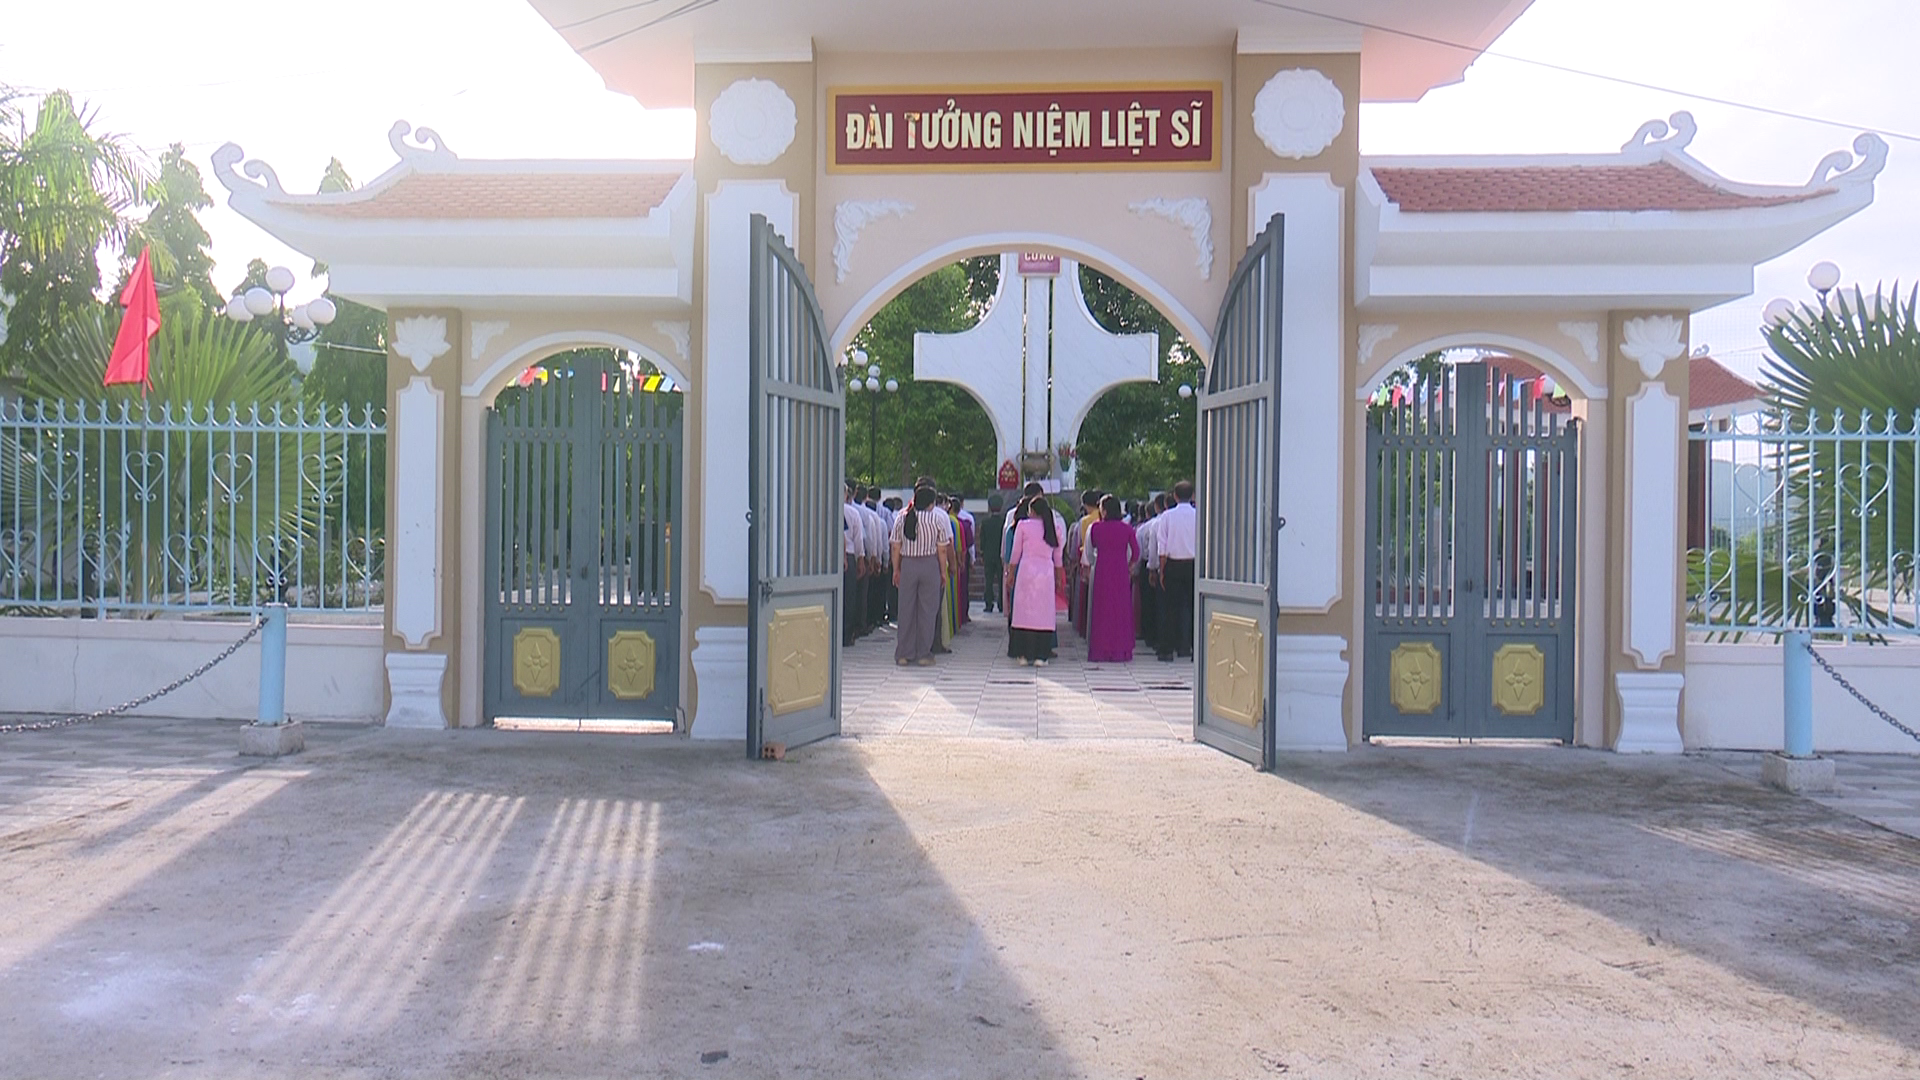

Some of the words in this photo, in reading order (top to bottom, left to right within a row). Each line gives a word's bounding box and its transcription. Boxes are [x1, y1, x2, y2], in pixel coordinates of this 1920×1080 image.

[846, 104, 893, 149] ĐÀI
[904, 98, 1002, 149] TƯỞNG
[1013, 103, 1091, 156] NIỆM
[1101, 101, 1161, 155] LIỆT
[1171, 100, 1203, 148] SĨ
